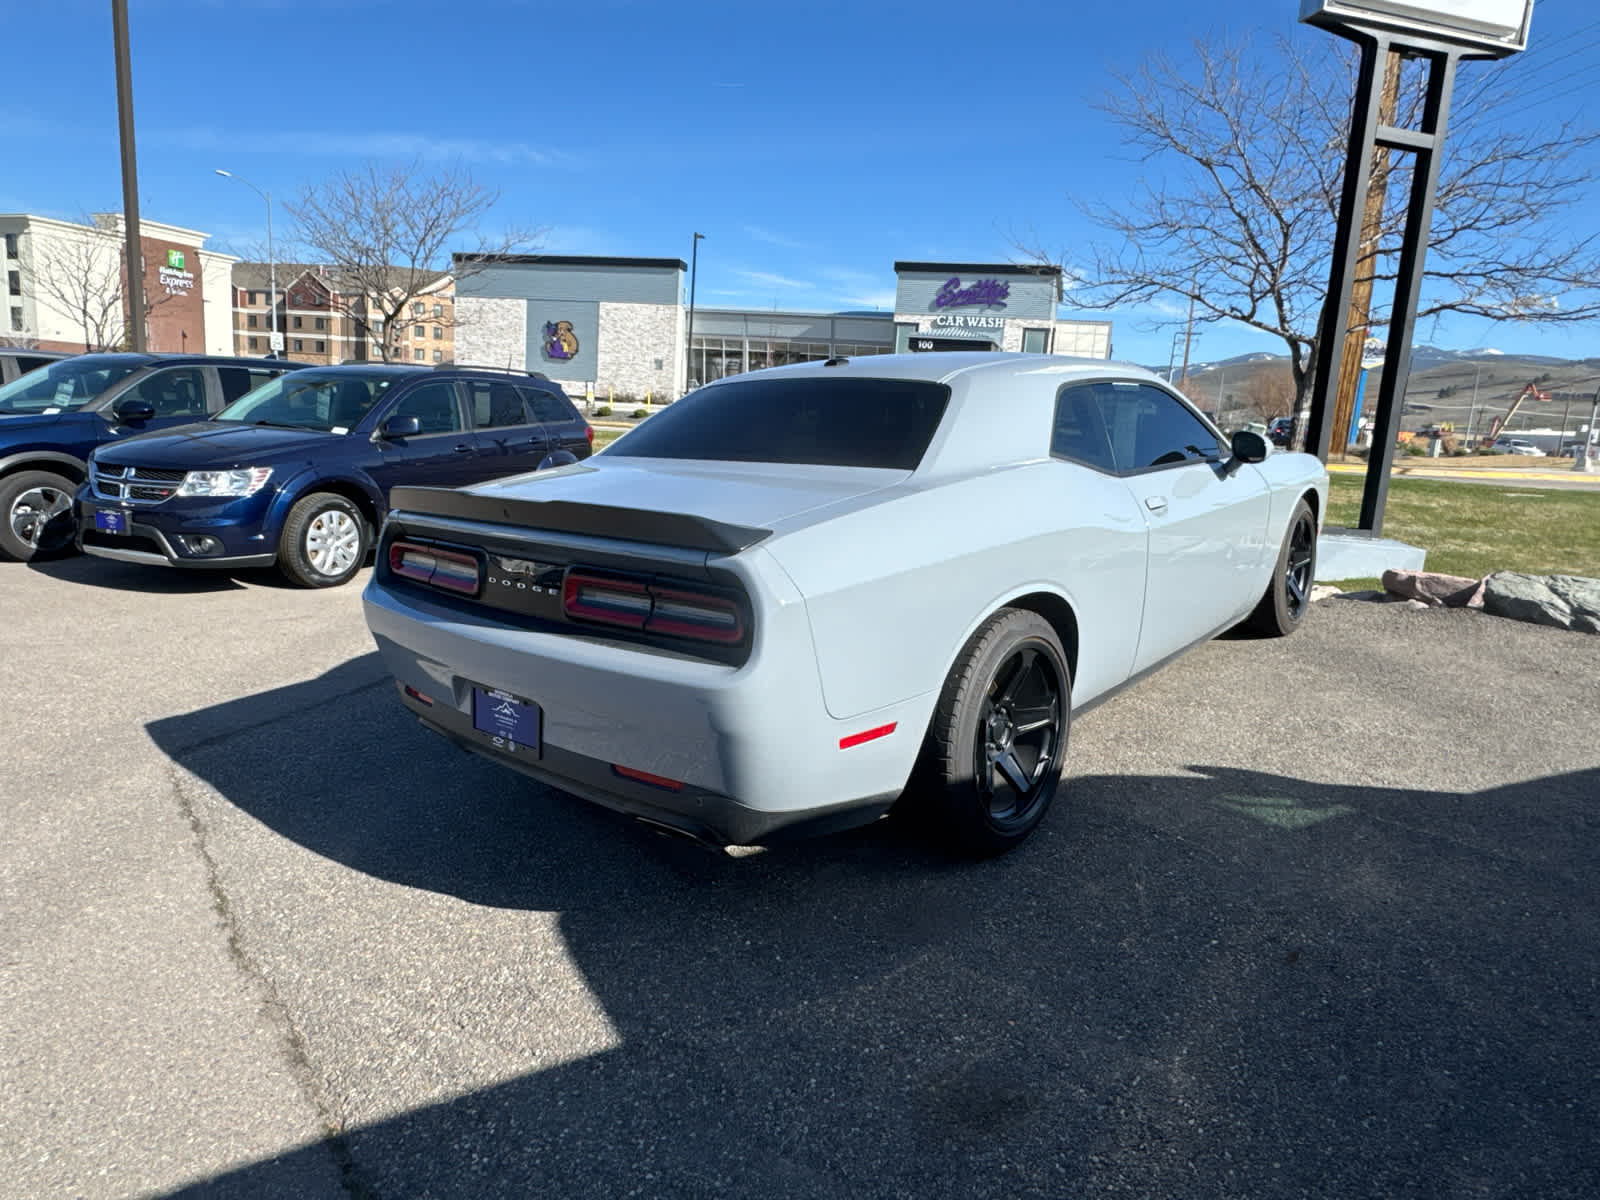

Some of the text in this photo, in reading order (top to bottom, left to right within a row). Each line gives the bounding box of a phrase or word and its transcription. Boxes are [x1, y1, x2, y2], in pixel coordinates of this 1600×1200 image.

[159, 273, 194, 288] Express
[936, 315, 1004, 328] CAR WASH
[918, 340, 933, 349] 100
[488, 577, 558, 595] DODGE
